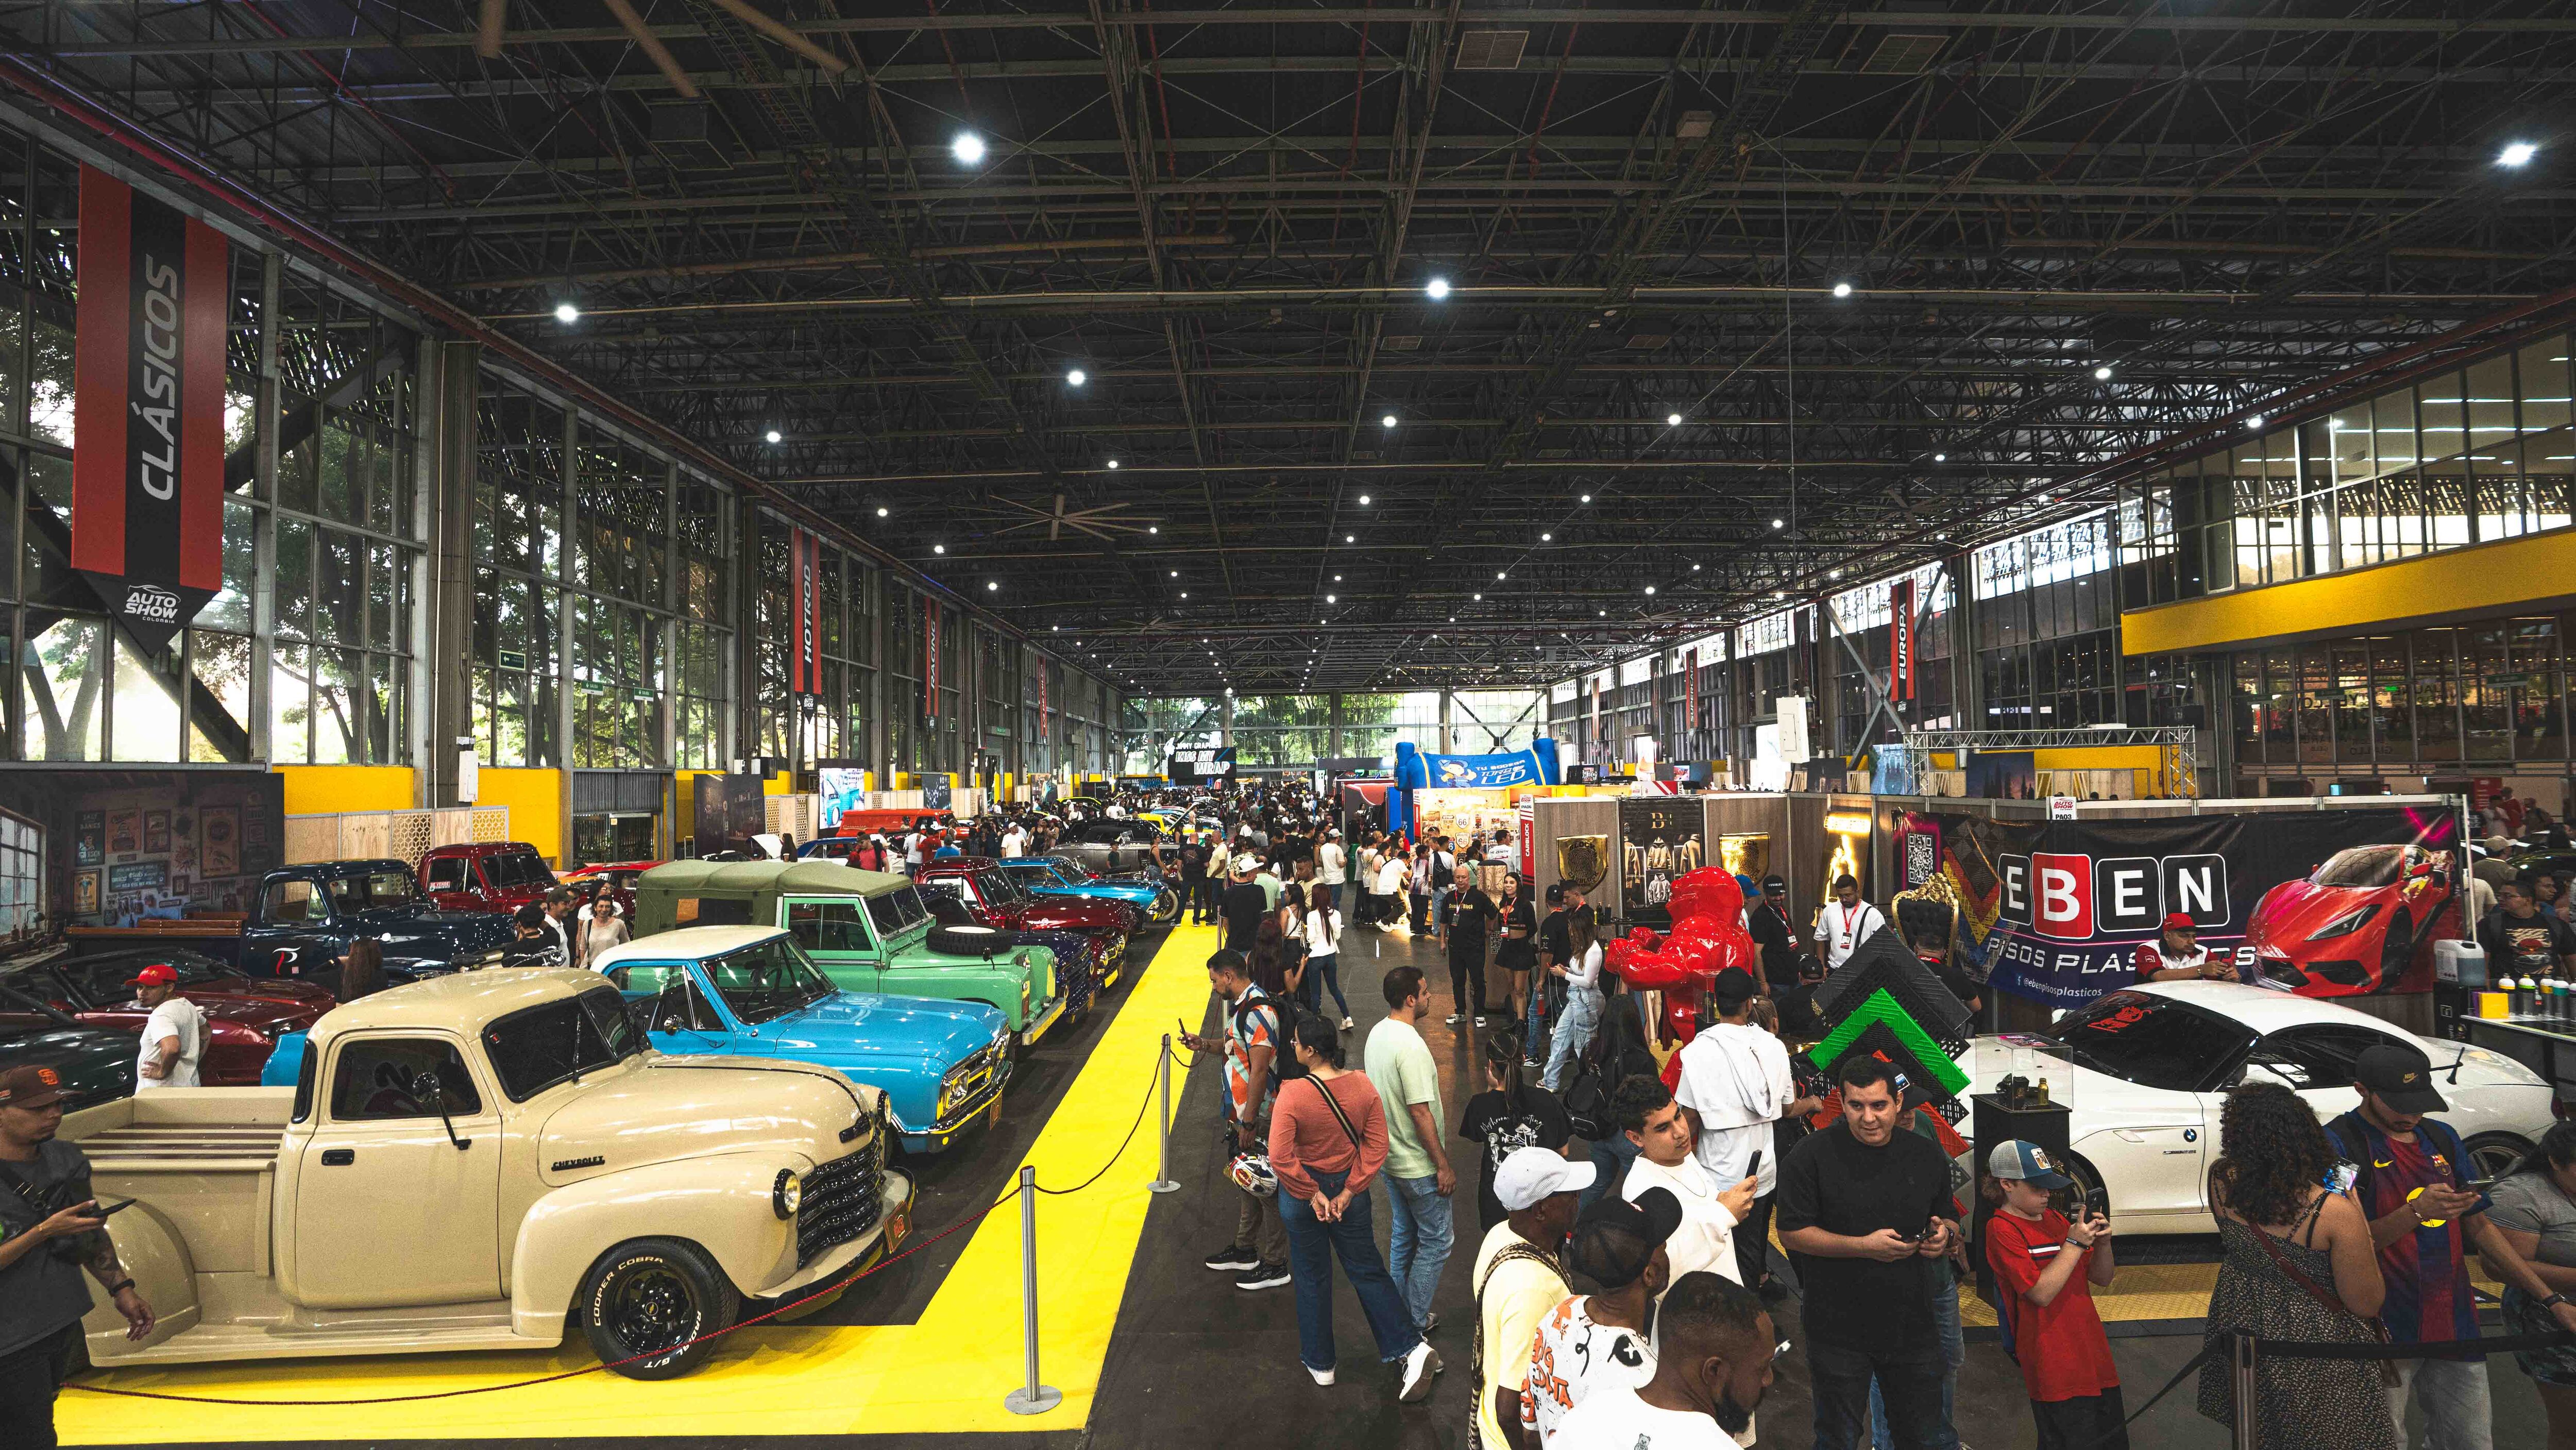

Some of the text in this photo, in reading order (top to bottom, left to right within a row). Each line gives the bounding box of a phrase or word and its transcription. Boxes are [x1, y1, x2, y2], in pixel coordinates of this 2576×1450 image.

[131, 254, 178, 500] CLÁSICOS
[127, 592, 176, 608] AUTO
[124, 602, 178, 618] SHOW
[1175, 750, 1215, 762] KISS MY
[1194, 761, 1230, 775] WRAP
[1490, 760, 1526, 770] BODEGA
[1481, 769, 1526, 784] LED
[2007, 866, 2212, 922] EBEN
[2023, 977, 2102, 997] @ebenpisosplasticos
[1522, 1115, 1544, 1130] unting
[552, 1155, 604, 1169] CHEVROLET
[594, 1256, 702, 1368] COOPER COBRA RADIAL G/T
